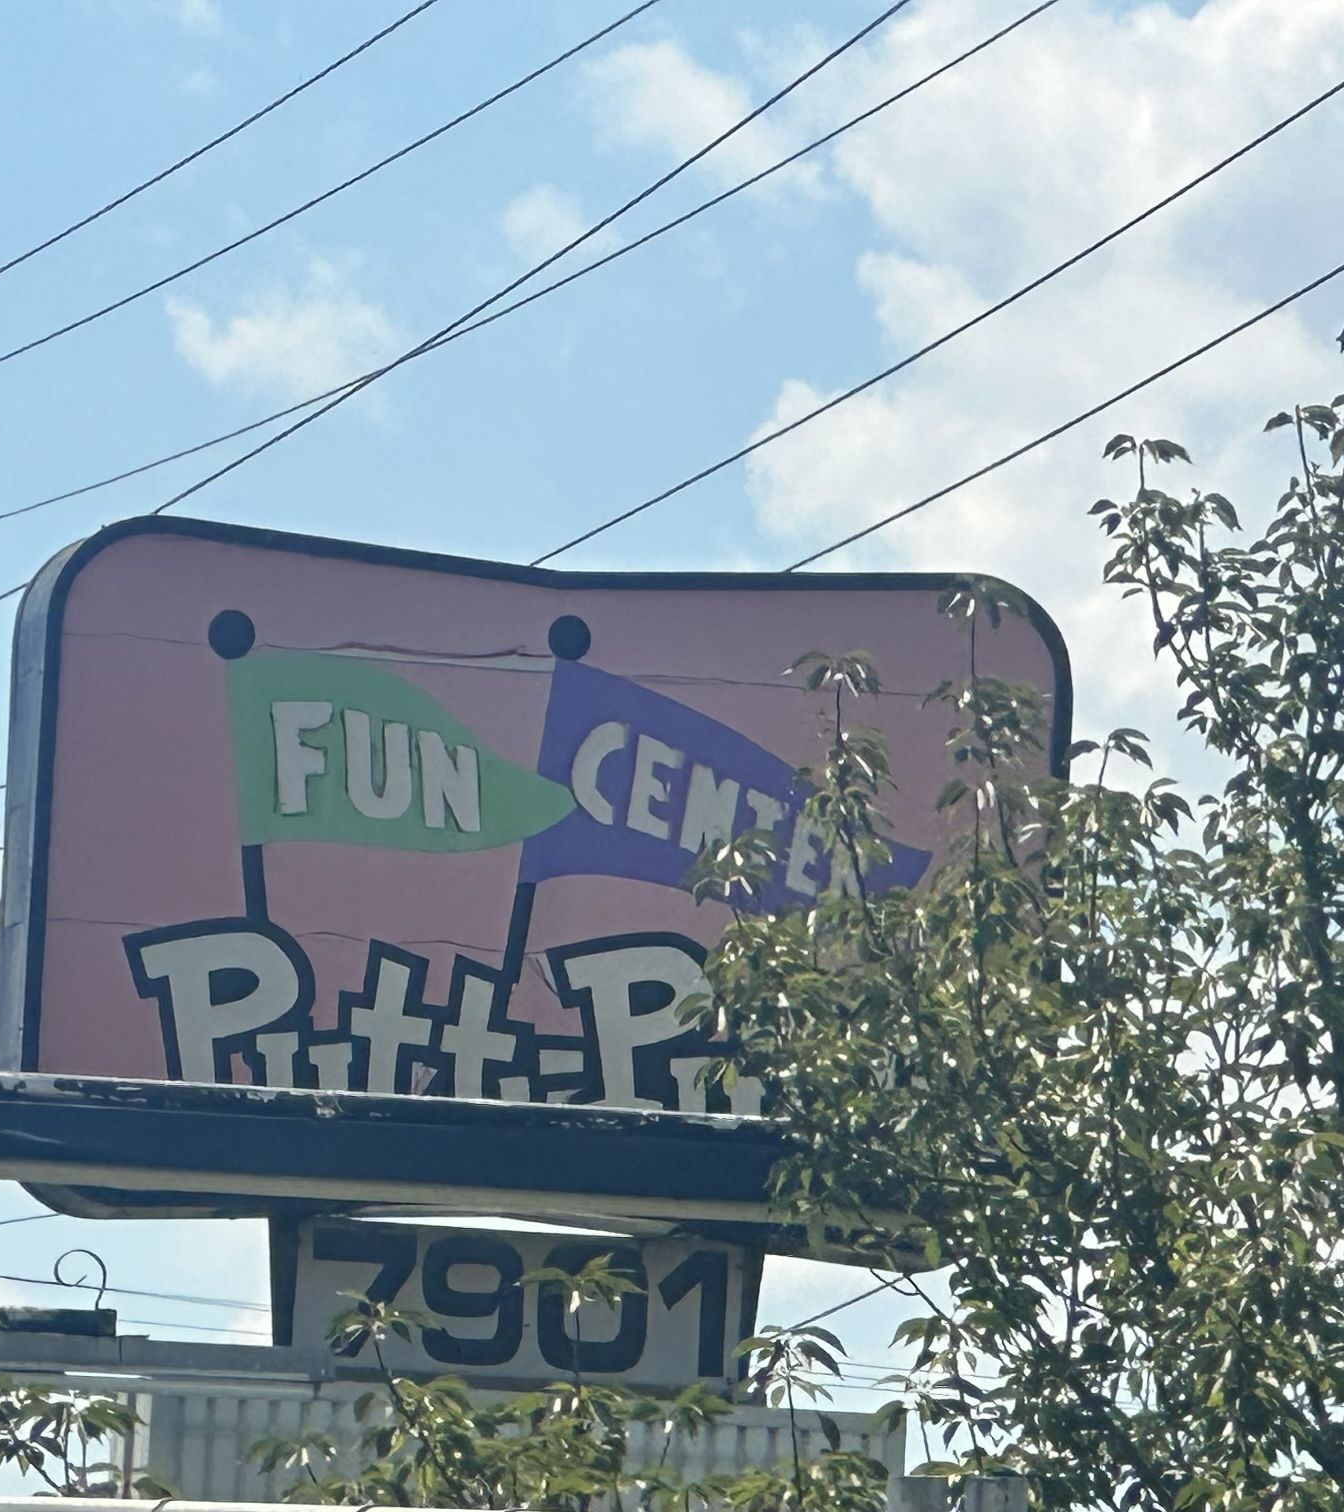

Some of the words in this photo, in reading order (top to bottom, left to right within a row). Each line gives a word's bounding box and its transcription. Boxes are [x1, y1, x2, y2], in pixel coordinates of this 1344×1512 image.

[270, 701, 481, 833] FUN
[136, 925, 768, 1112] Putt-Pu
[311, 1225, 729, 1378] 7901
